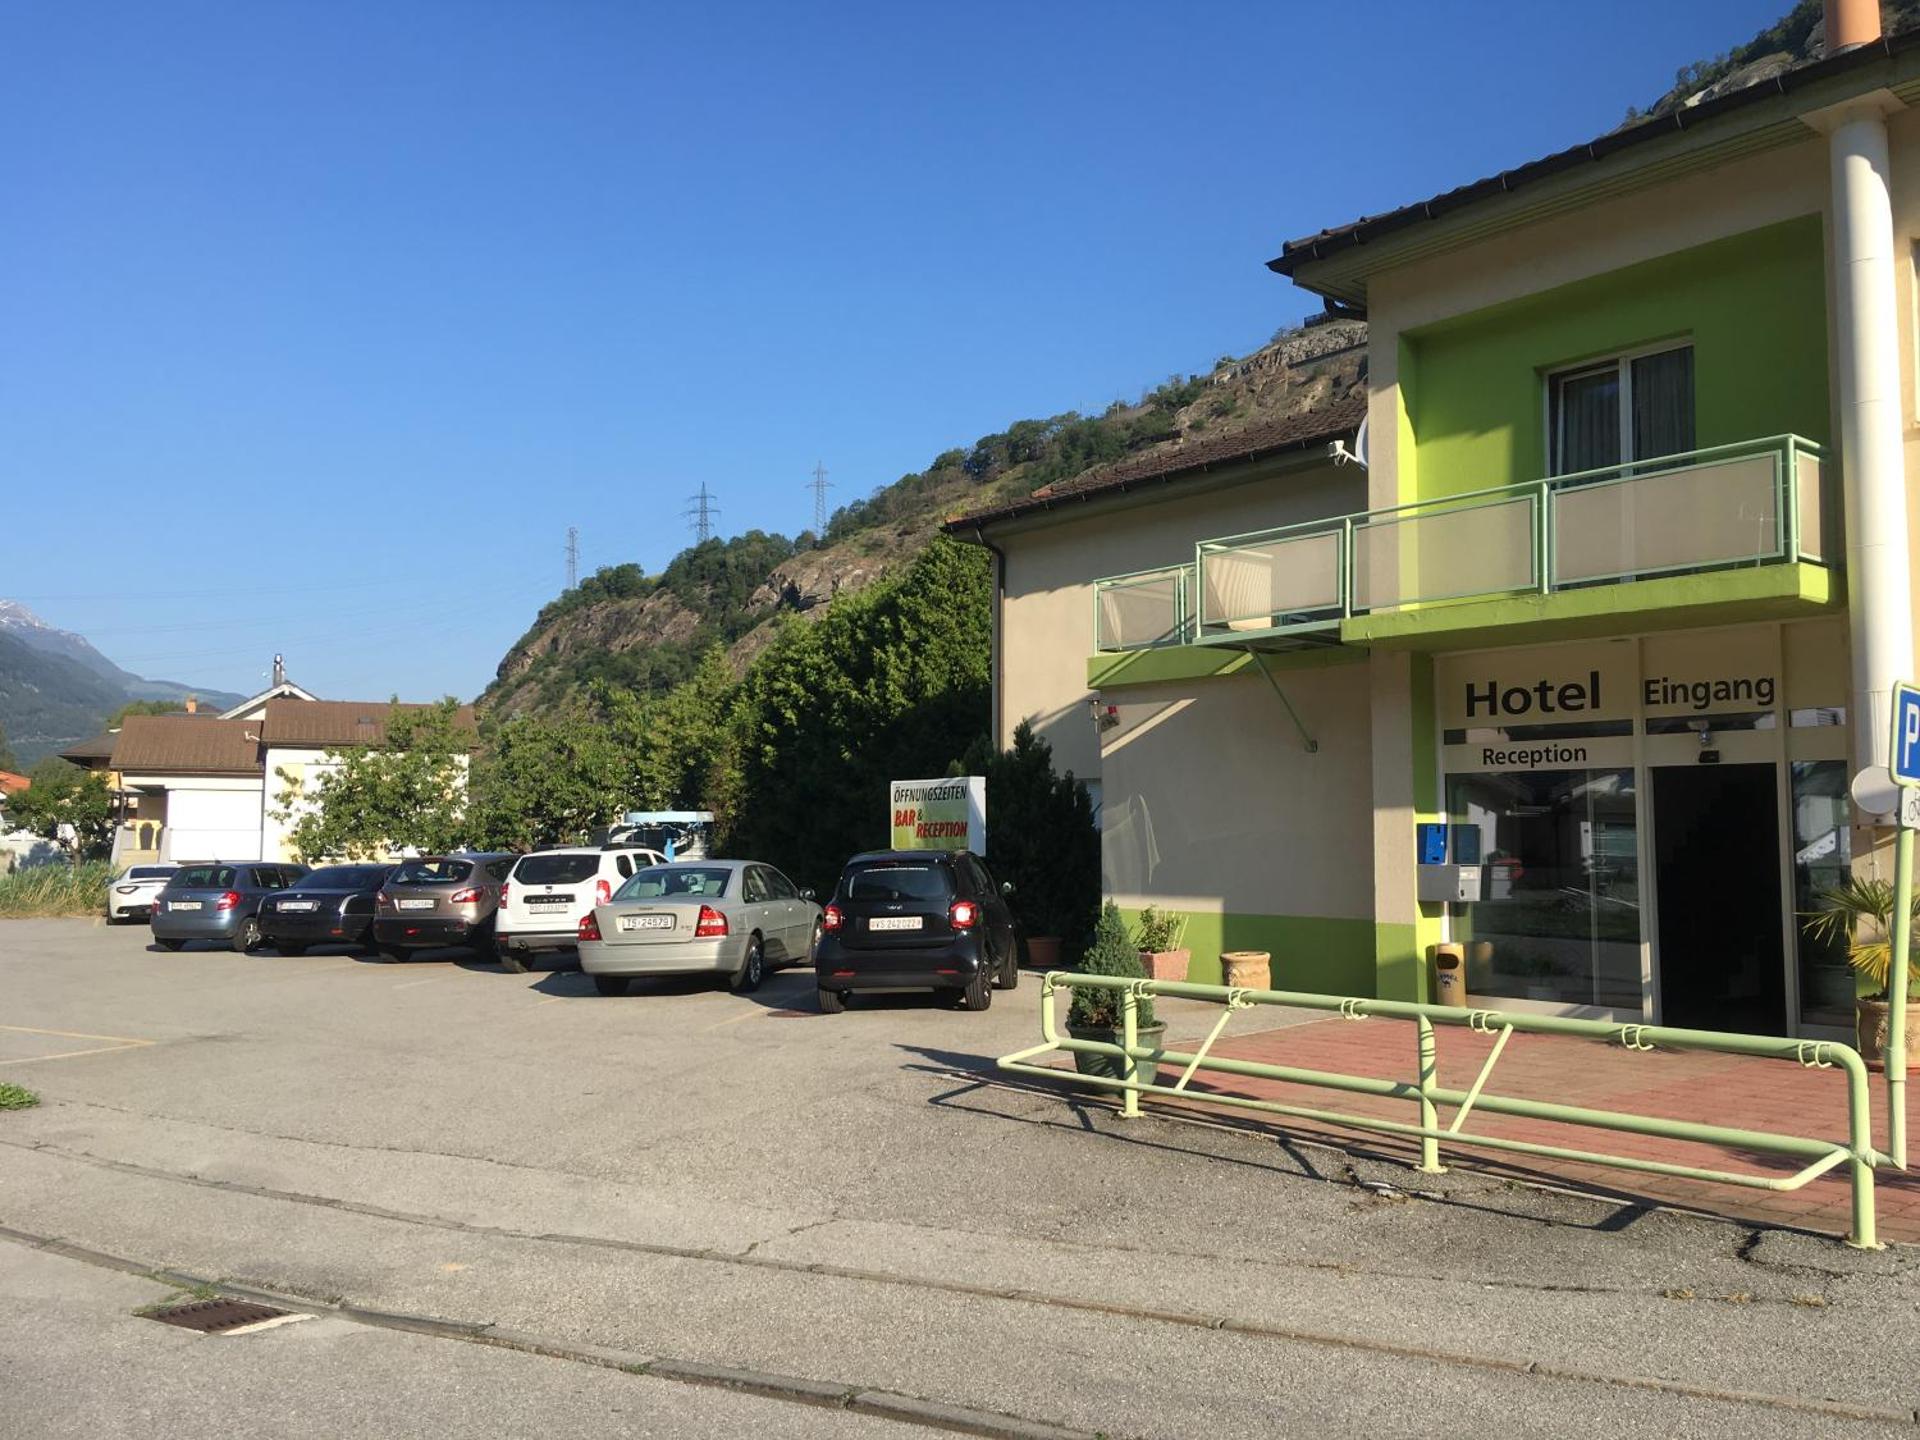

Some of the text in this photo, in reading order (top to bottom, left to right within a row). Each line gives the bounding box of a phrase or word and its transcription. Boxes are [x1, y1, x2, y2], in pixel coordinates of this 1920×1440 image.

[1465, 671, 1600, 717] Hotel
[1644, 677, 1775, 710] Eingang
[1903, 702, 1920, 769] P
[1482, 744, 1587, 768] Reception
[894, 785, 967, 803] ÖFFNUNGSZEITEN
[894, 808, 924, 827] BAR &
[916, 821, 968, 838] RECEPTION
